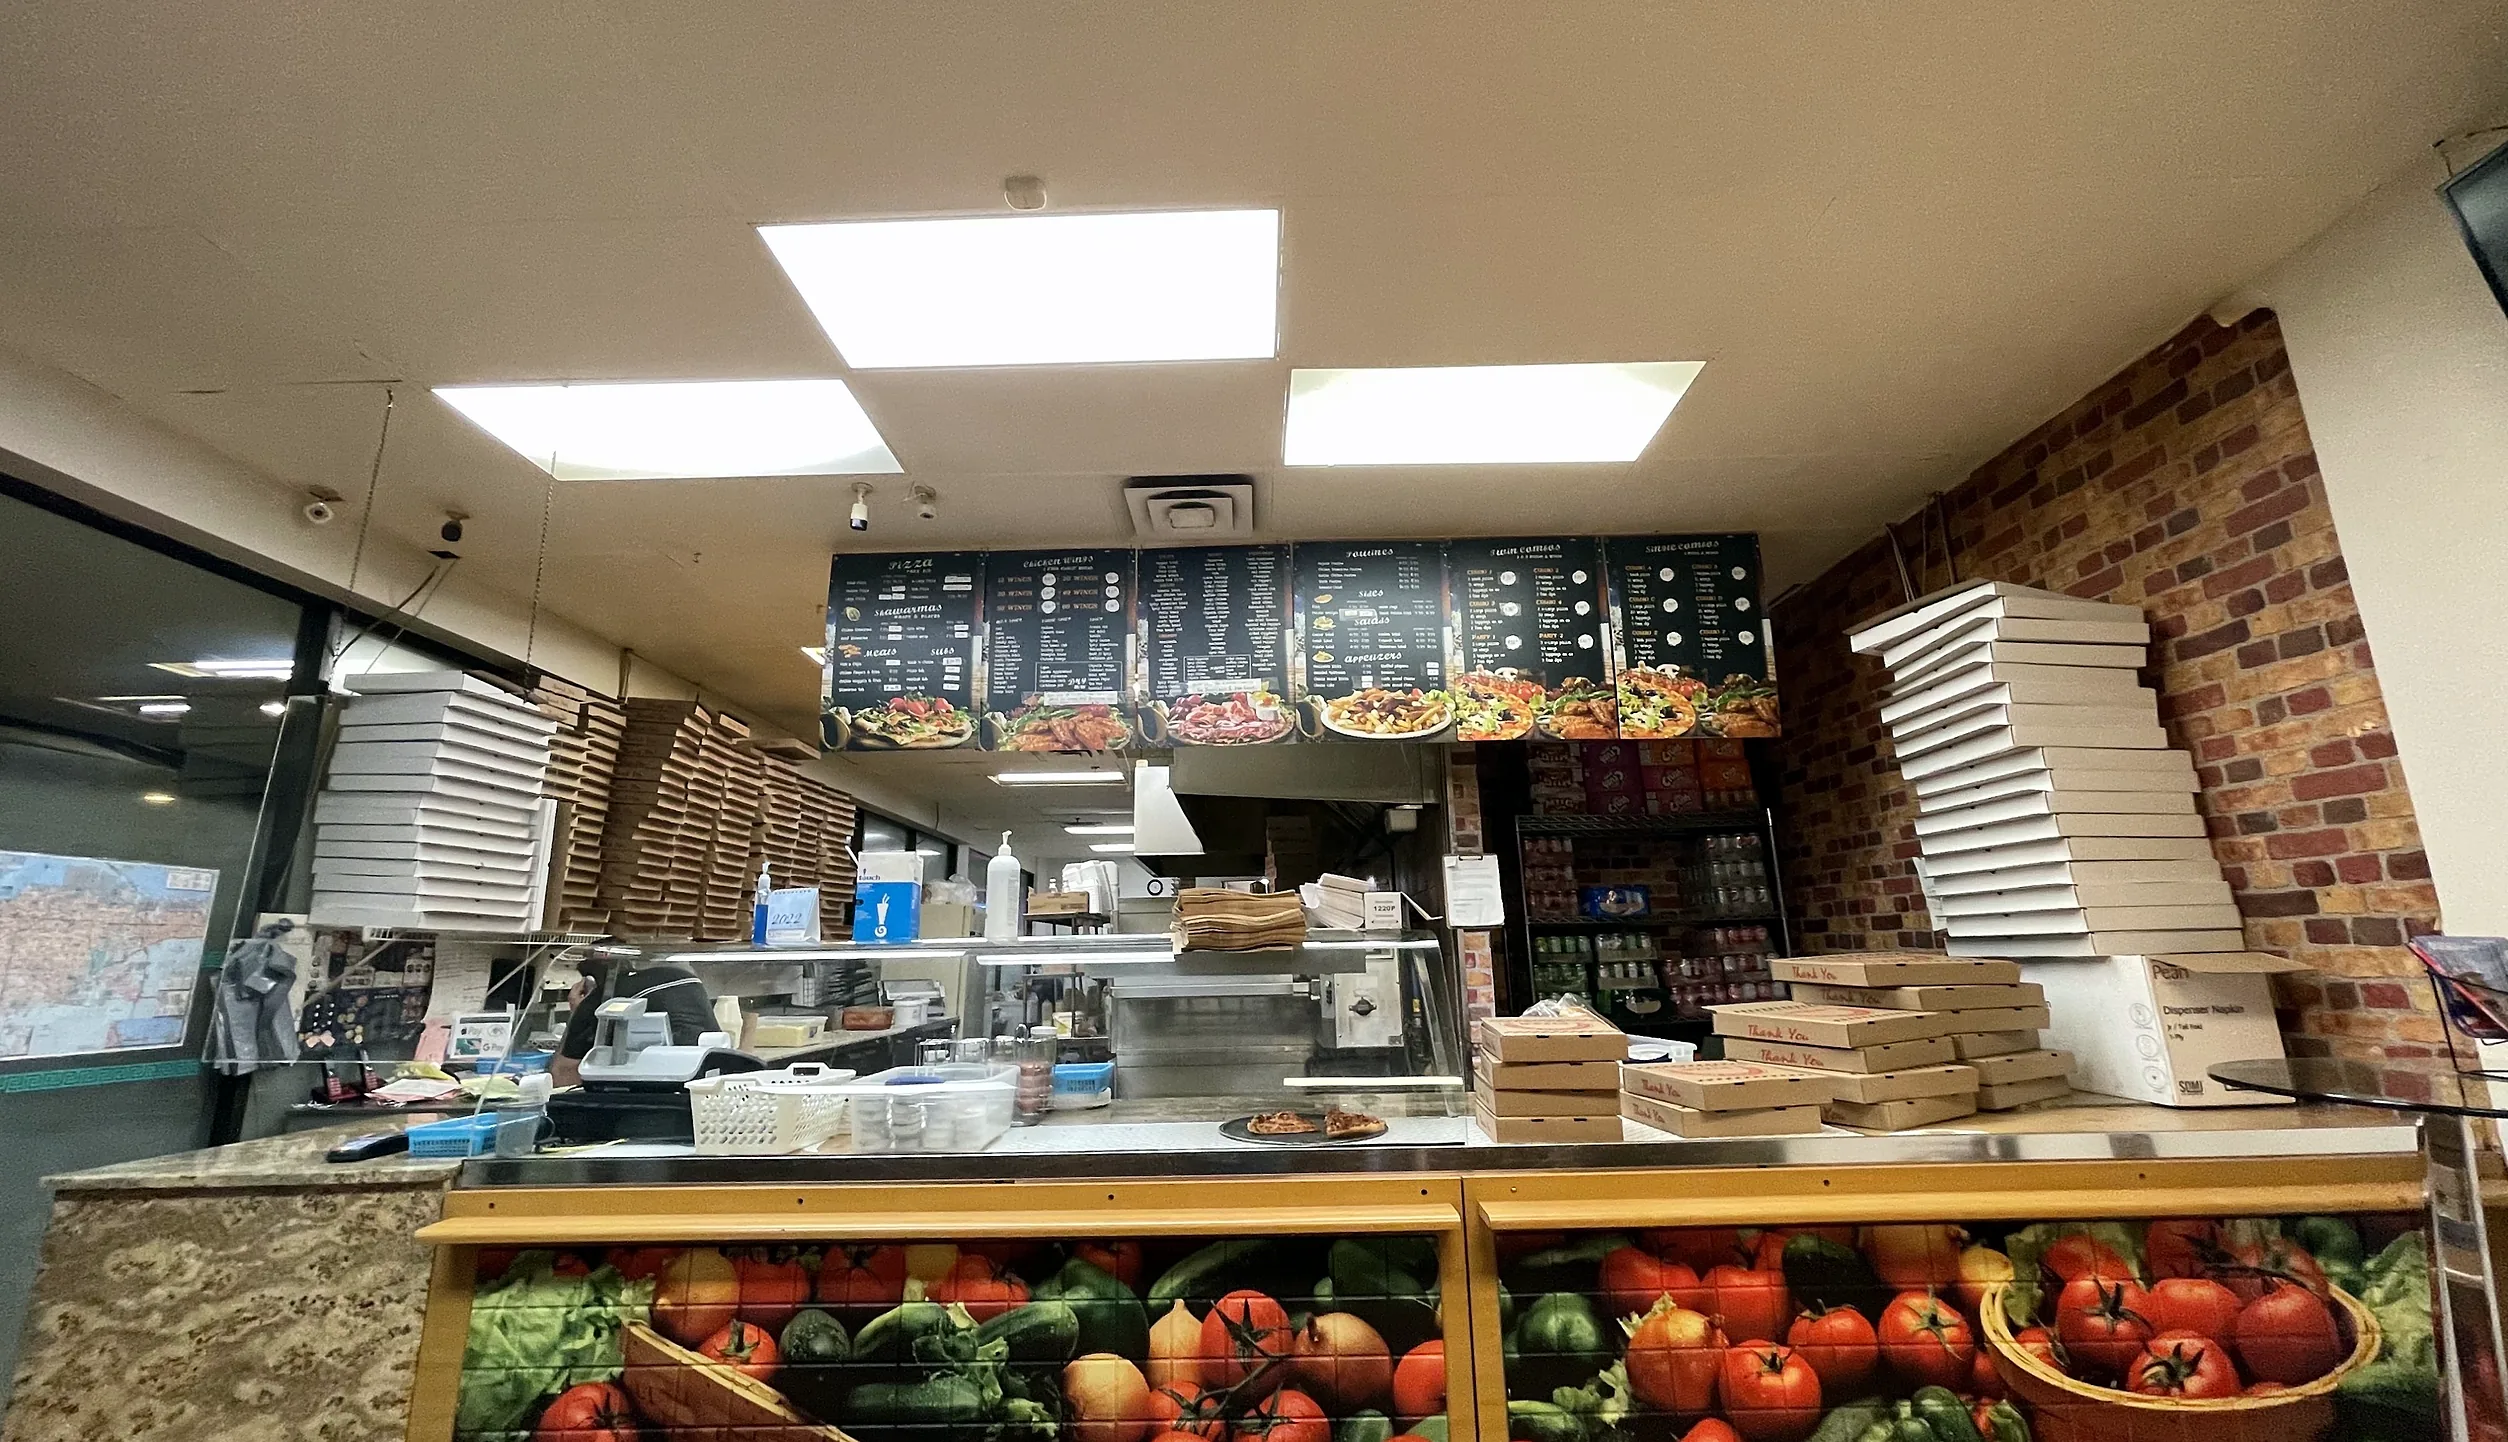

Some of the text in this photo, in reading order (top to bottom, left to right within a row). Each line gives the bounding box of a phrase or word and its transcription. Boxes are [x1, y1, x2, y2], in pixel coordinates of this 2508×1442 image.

[1490, 544, 1560, 557] Twin Combos
[889, 559, 932, 571] Pizza
[1024, 559, 1062, 569] Chicken
[1353, 617, 1390, 625] Salads
[772, 913, 802, 925] 2022
[1792, 966, 1838, 980] Thank You
[1821, 988, 1881, 1004] Thank You
[2163, 1006, 2208, 1016] Dispenser
[1748, 1024, 1809, 1040] Thank You
[1761, 1049, 1823, 1066] Thank You
